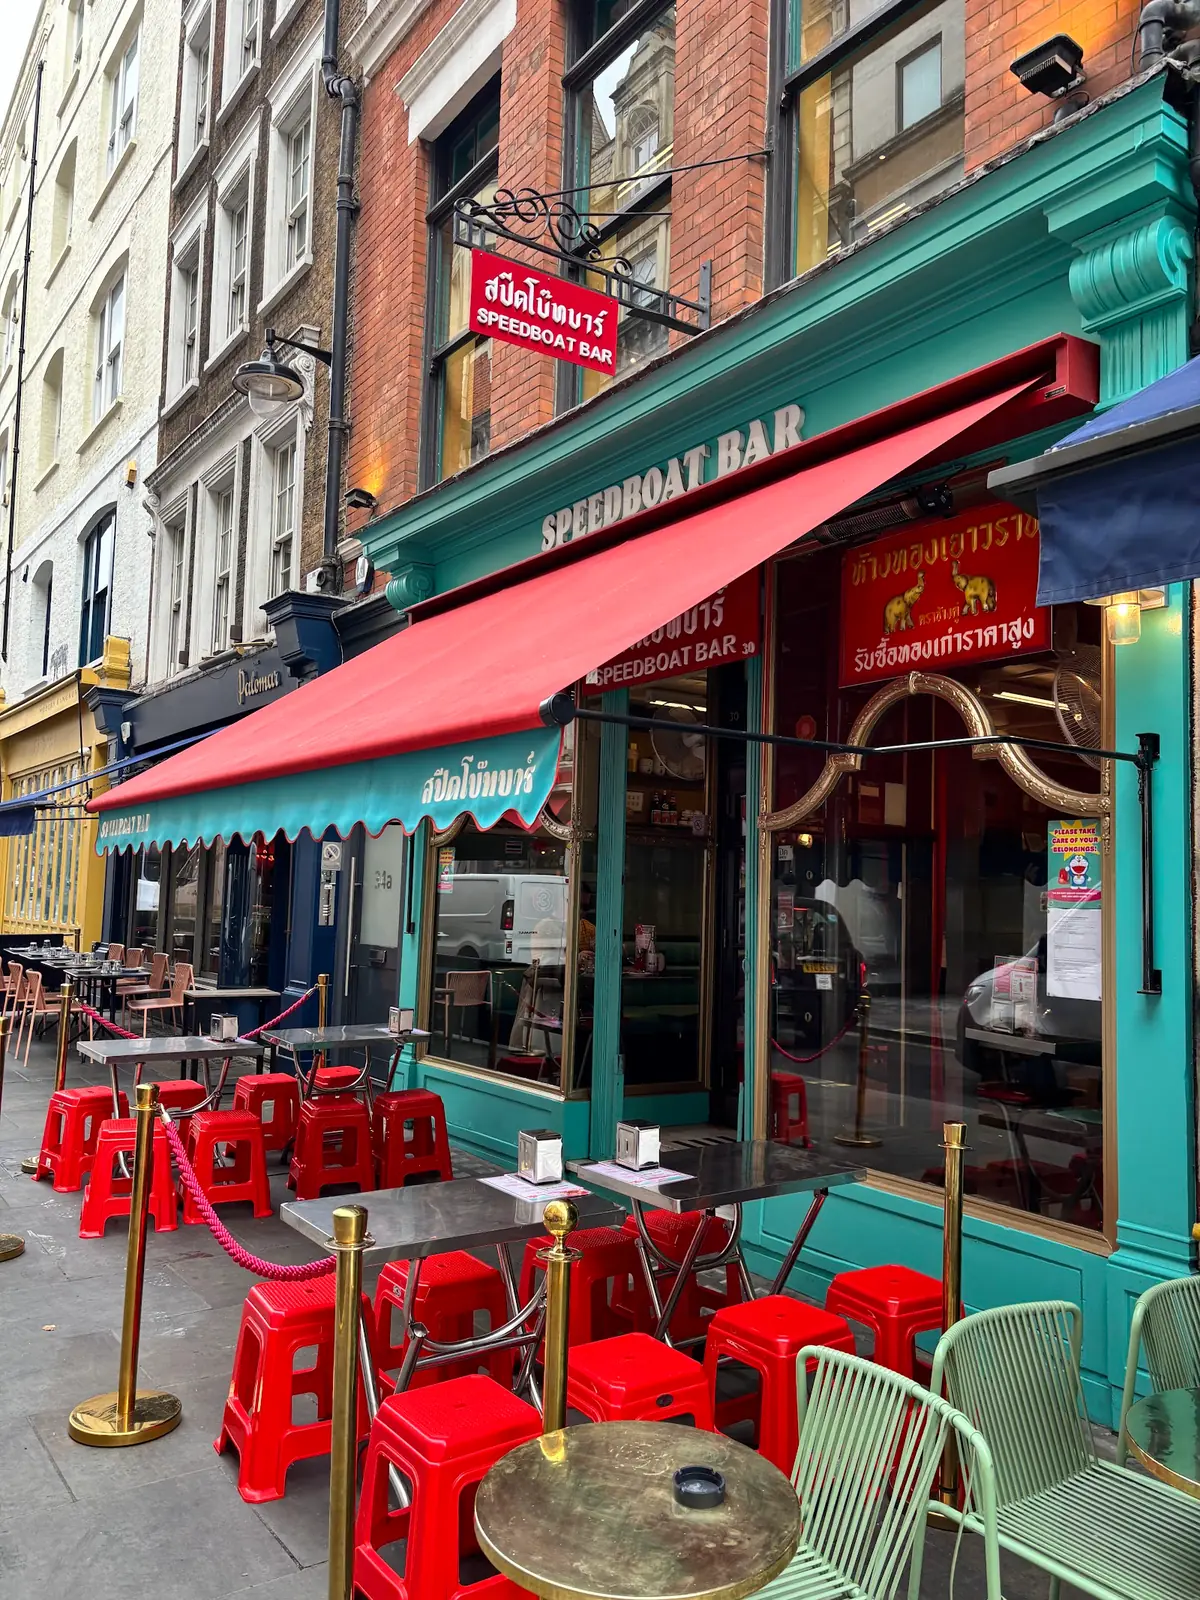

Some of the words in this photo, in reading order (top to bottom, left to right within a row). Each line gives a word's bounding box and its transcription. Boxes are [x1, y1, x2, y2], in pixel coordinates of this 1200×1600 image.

[477, 307, 577, 352] SPEEDBOAT
[579, 341, 613, 365] BAR
[541, 444, 710, 551] SPEEDBOAT
[716, 404, 805, 479] BAR
[596, 645, 692, 686] SPEEDBOAT
[695, 634, 737, 663] BAR
[742, 641, 756, 655] 30
[237, 668, 279, 706] Palomar
[421, 750, 537, 804] สปีดโบ๊ทบาร์
